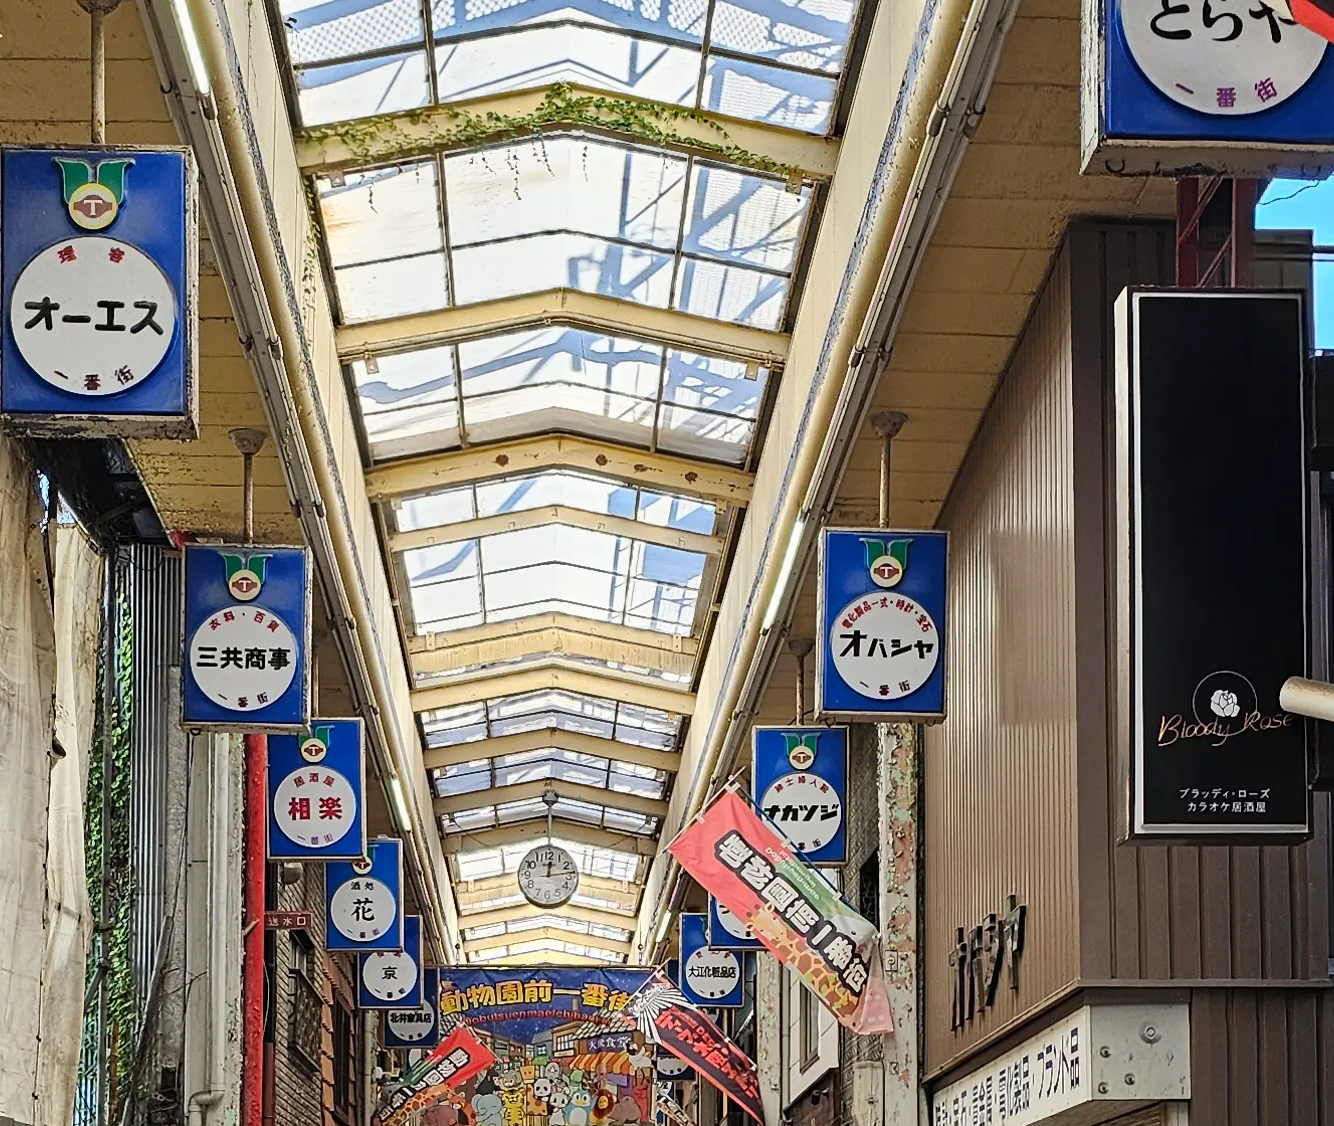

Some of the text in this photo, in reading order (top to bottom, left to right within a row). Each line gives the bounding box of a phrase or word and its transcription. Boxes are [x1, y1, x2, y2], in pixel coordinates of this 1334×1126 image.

[1175, 77, 1277, 108] 一番街
[57, 244, 126, 264] 理容
[24, 296, 164, 336] オーエス
[53, 365, 135, 391] 一番街
[196, 646, 291, 671] 三共商事
[859, 679, 911, 696] 一番街
[217, 691, 269, 708] 一番街
[1158, 711, 1295, 747] Bloody Rose
[293, 772, 335, 788] 居酒屋
[1178, 787, 1271, 800] ブラッディ・ローズ
[288, 796, 343, 822] 相楽
[764, 804, 840, 822] ナカツジ
[1187, 801, 1267, 813] カラオケ居酒屋
[350, 898, 376, 922] 花
[268, 916, 307, 927] 送水口
[381, 966, 398, 980] 京
[688, 965, 737, 978] 大江化粧品店
